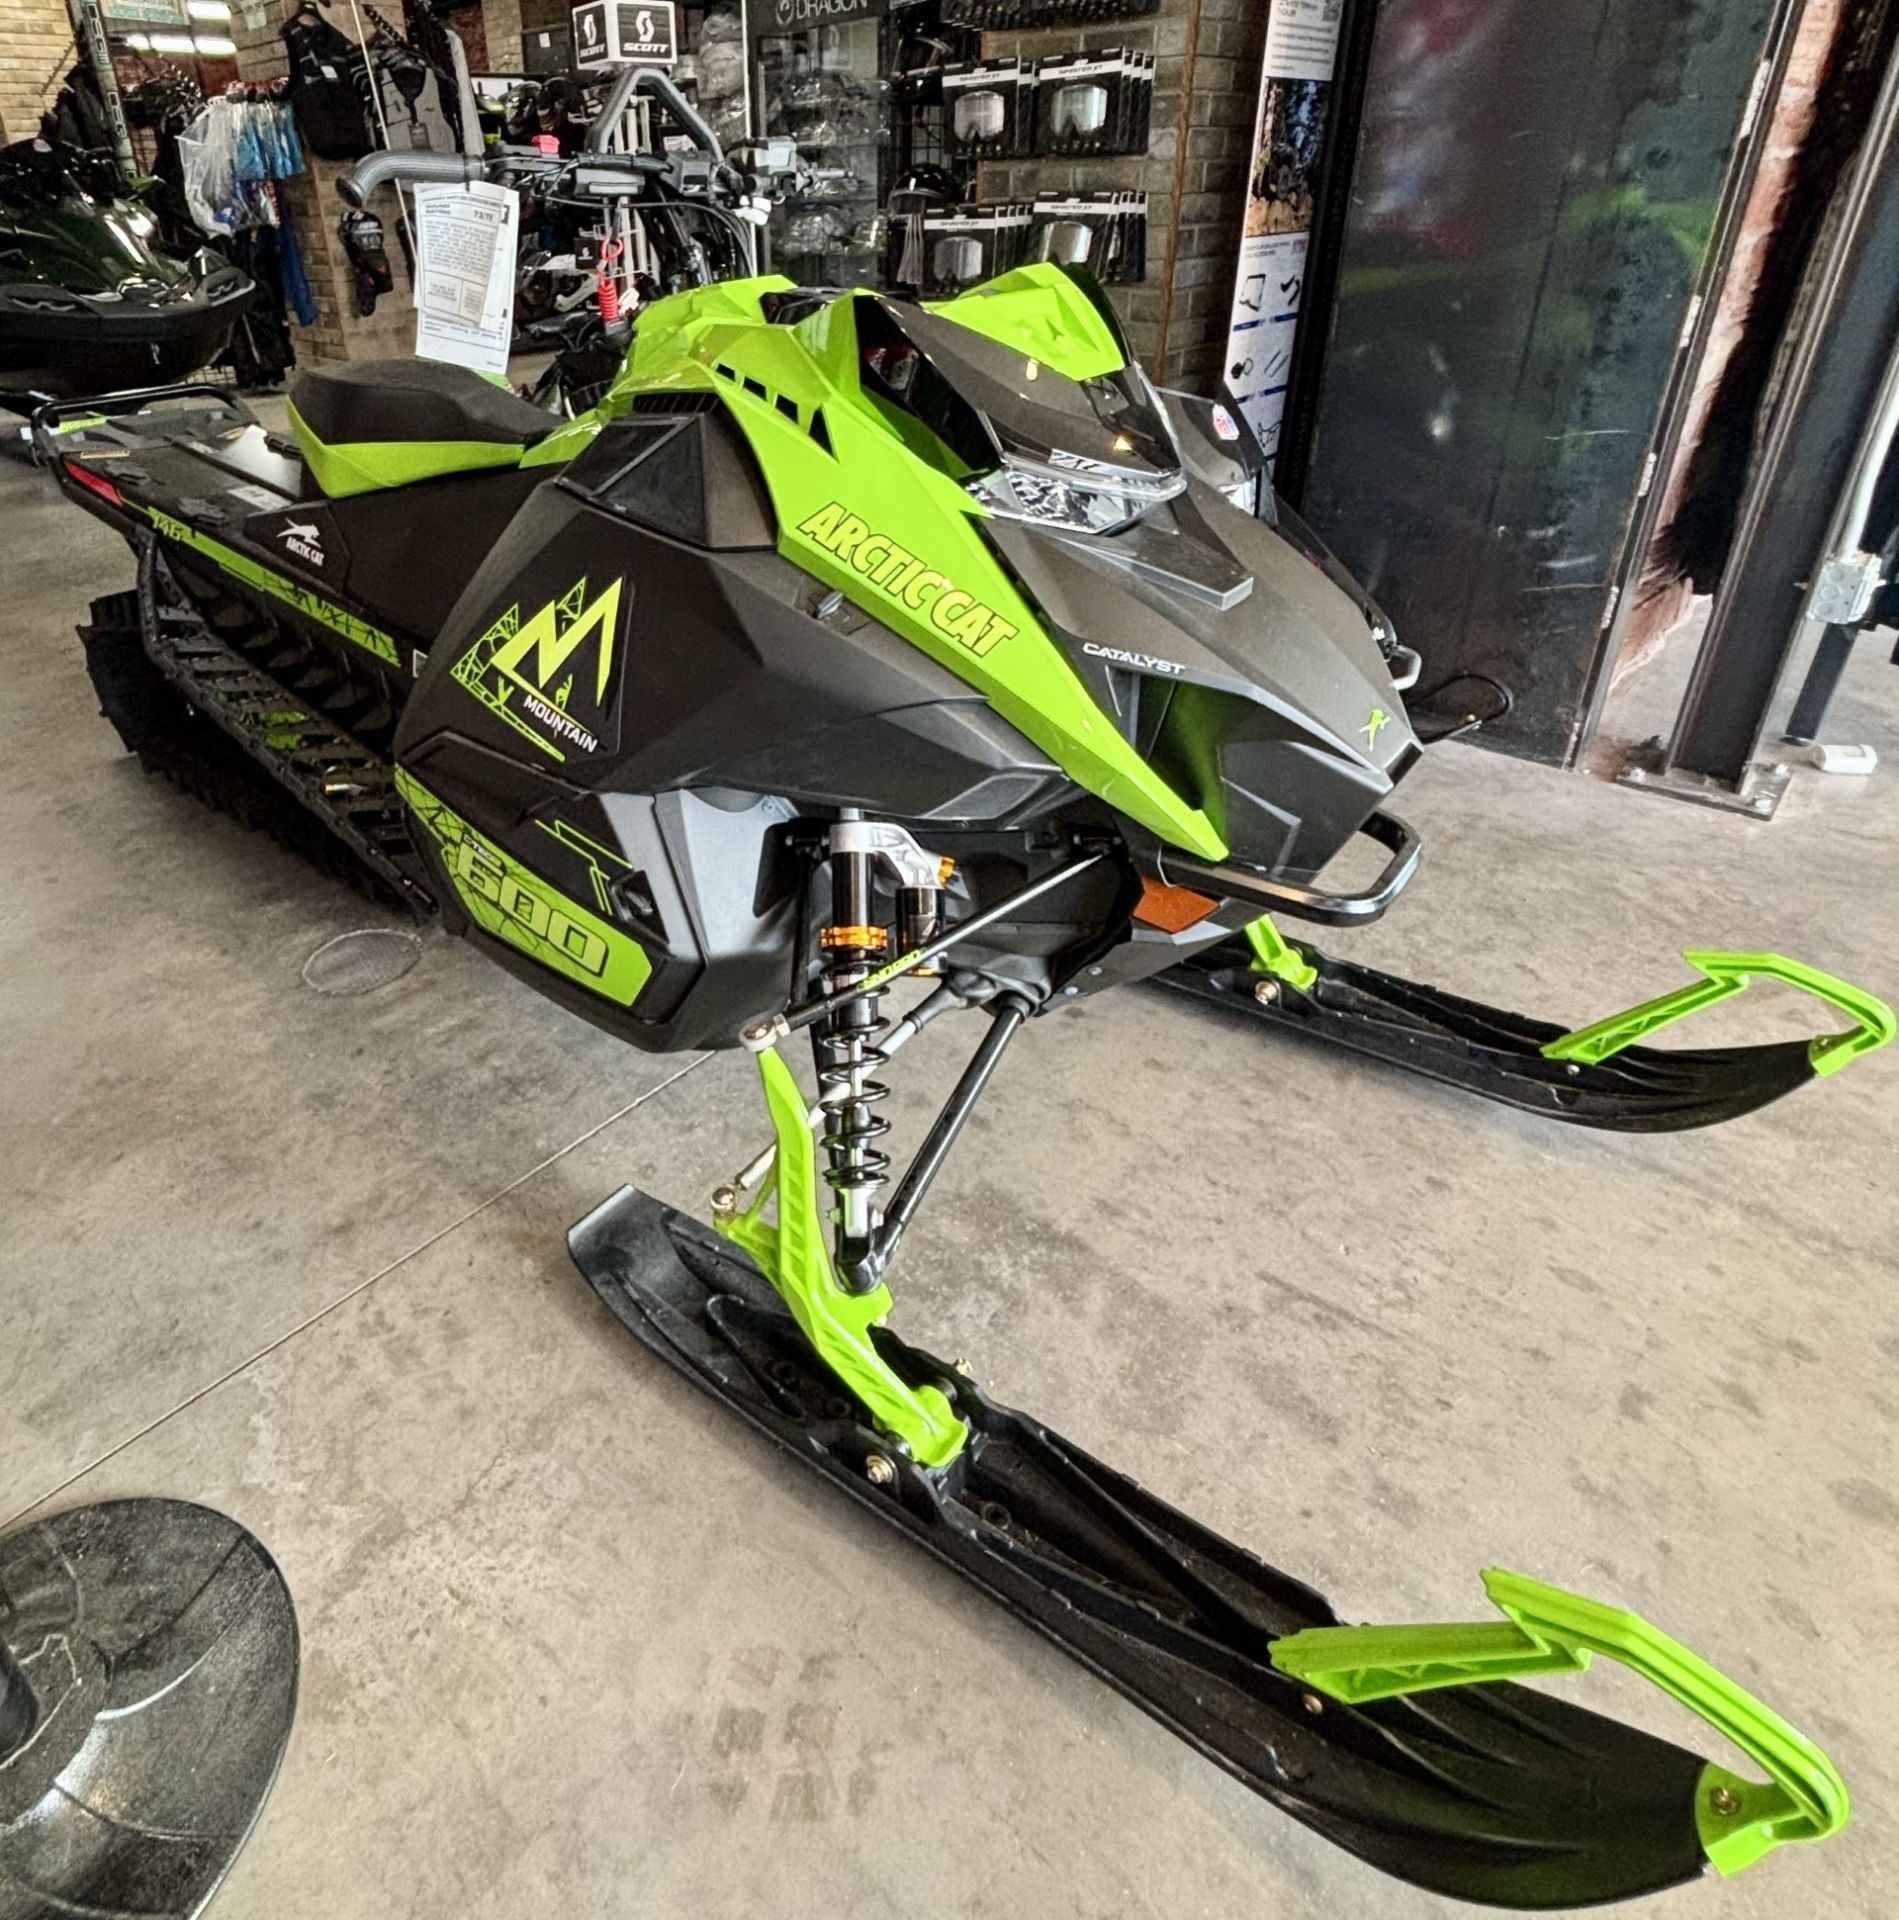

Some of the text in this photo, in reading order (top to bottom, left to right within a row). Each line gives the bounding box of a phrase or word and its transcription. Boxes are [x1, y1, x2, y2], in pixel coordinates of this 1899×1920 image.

[579, 43, 606, 58] SCOTT
[622, 42, 669, 53] SCOTT
[286, 536, 325, 566] ARCTIC CAT
[796, 500, 1021, 659] ARCTIC CAT
[1082, 642, 1186, 675] CATALYST
[523, 694, 599, 754] MOUNTAIN
[456, 841, 610, 979] 600
